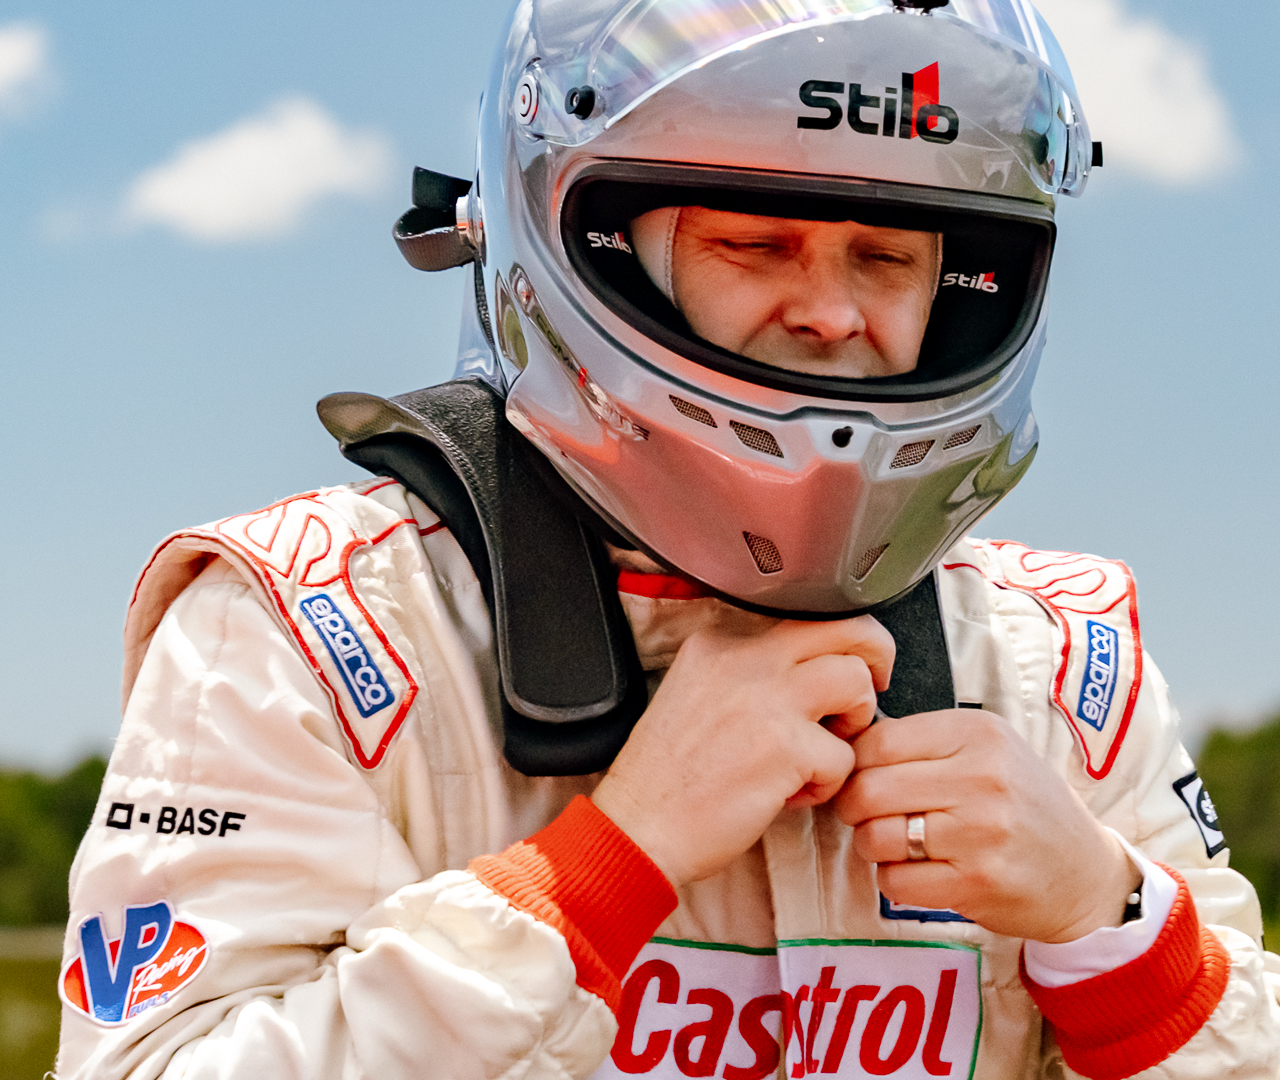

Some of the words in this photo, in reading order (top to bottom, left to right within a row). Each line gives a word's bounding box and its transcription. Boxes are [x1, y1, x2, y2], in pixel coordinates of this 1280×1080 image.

[796, 68, 960, 145] Stilo
[586, 231, 632, 254] Stilo
[941, 272, 999, 293] Stilo
[310, 598, 387, 706] sparco
[1082, 624, 1109, 721] sparco
[156, 806, 247, 837] BASF
[80, 902, 172, 1023] VP
[132, 943, 209, 1006] Racing
[609, 958, 959, 1080] Castrol
